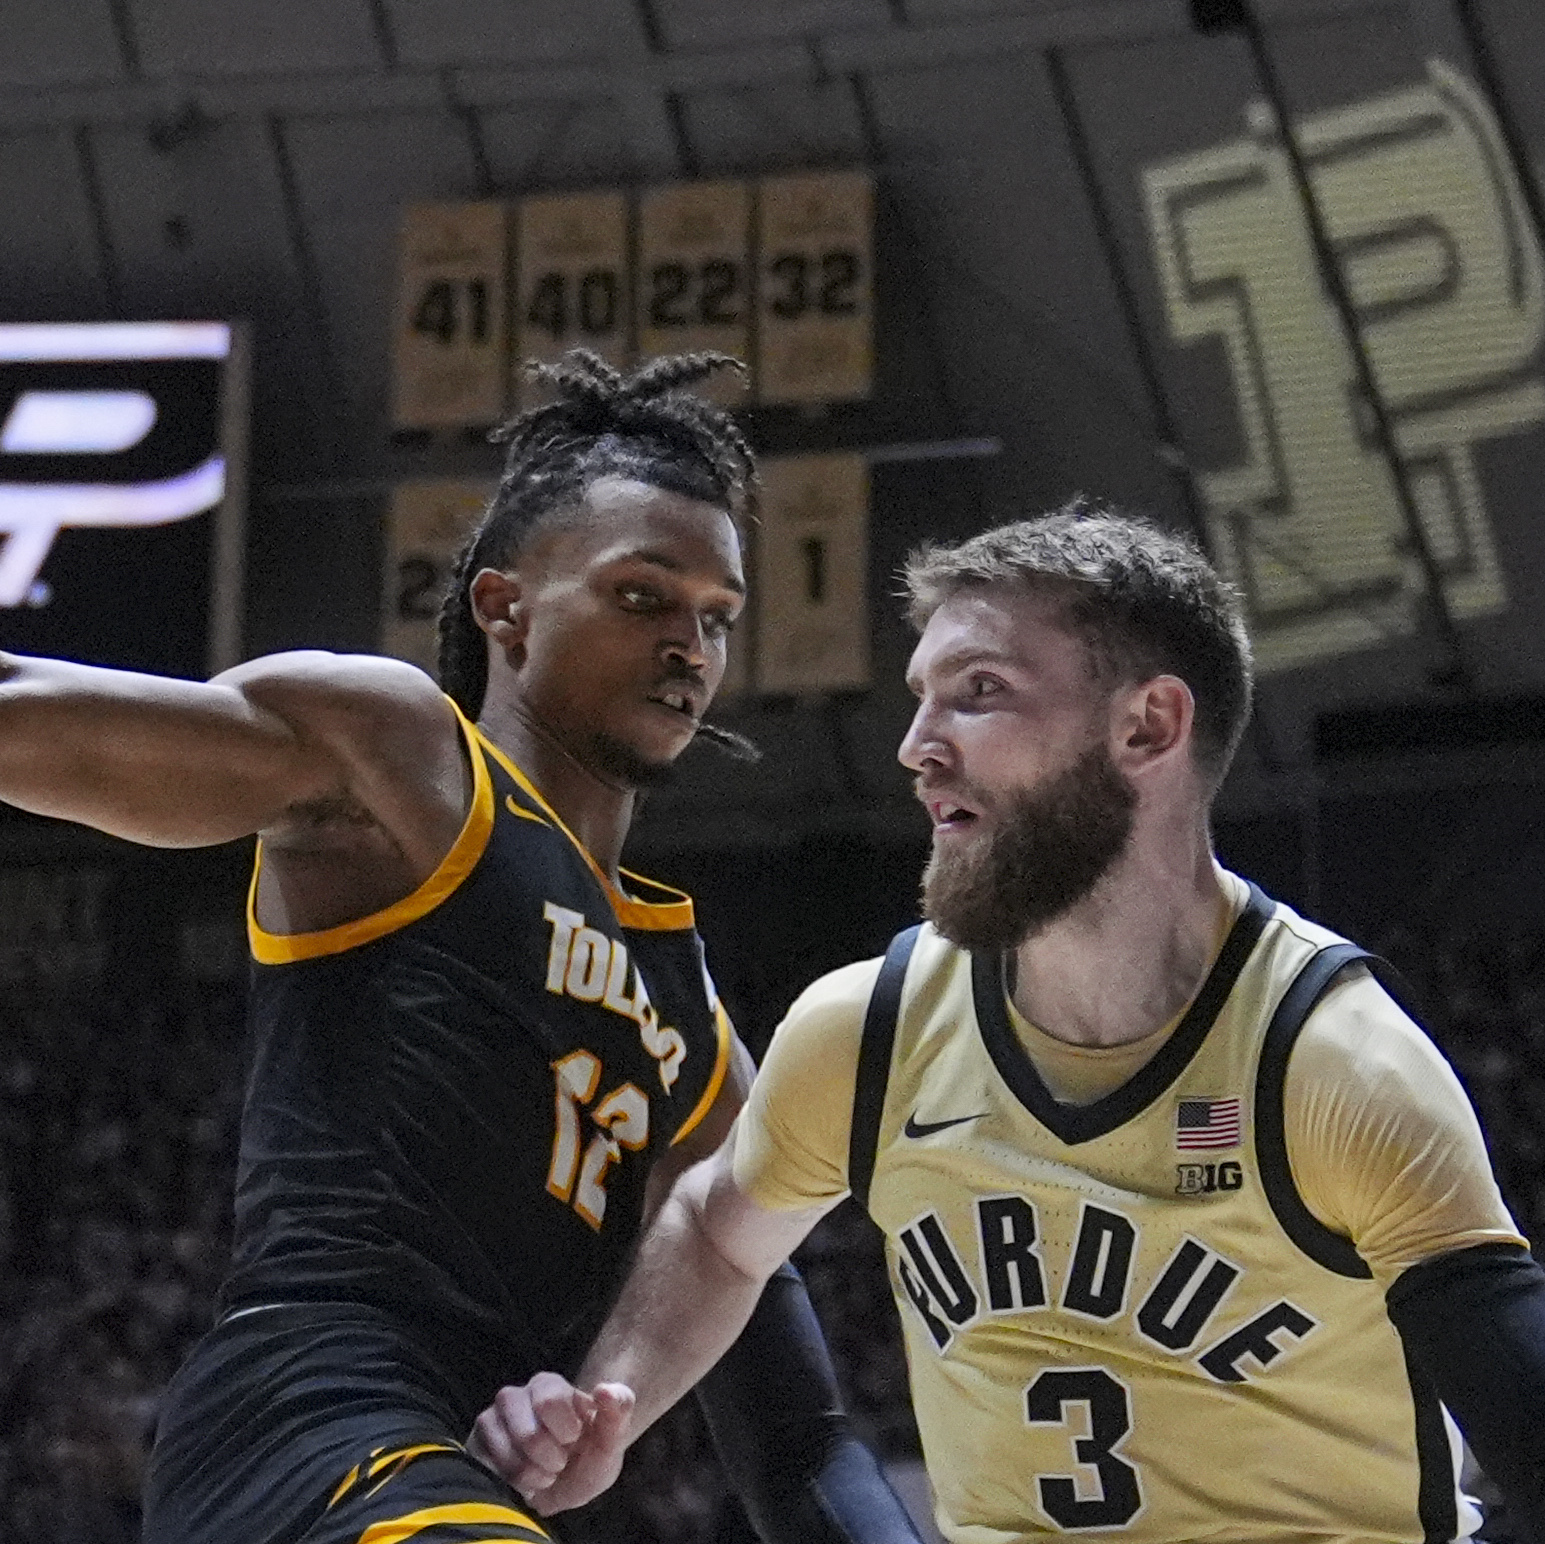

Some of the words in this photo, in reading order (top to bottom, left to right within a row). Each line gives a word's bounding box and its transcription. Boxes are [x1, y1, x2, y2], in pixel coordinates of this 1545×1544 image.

[410, 272, 491, 347] 41
[524, 260, 621, 338] 40
[649, 254, 742, 330] 22
[768, 245, 867, 321] 32
[397, 556, 440, 622] 2
[799, 535, 827, 602] 1
[546, 1049, 650, 1233] 12
[1023, 1366, 1147, 1532] 3
